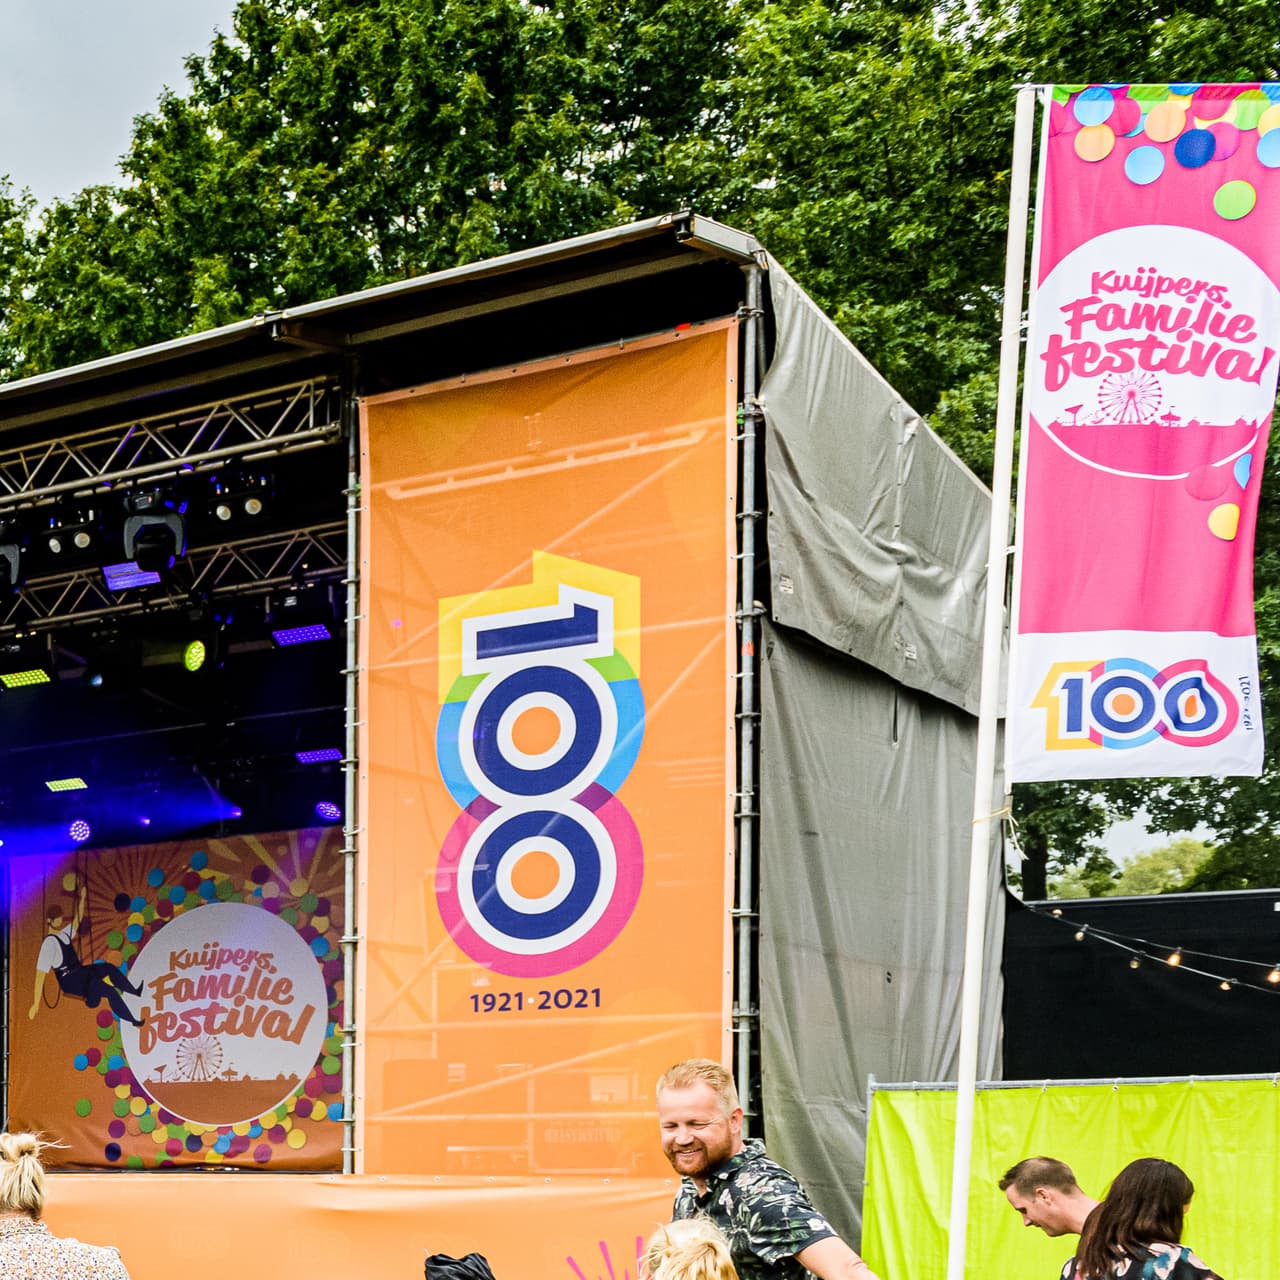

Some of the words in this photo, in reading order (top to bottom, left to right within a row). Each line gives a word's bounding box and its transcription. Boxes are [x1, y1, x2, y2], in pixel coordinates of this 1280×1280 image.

[1091, 267, 1228, 304] Kuijpers
[1059, 294, 1258, 342] Familie
[1039, 329, 1276, 392] festival
[1046, 668, 1228, 741] 100
[456, 583, 618, 955] 100
[169, 941, 274, 972] Kuijpers
[148, 964, 295, 1011] Familie
[470, 992, 525, 1014] 1921
[537, 987, 602, 1011] 2021
[137, 994, 316, 1056] festival
